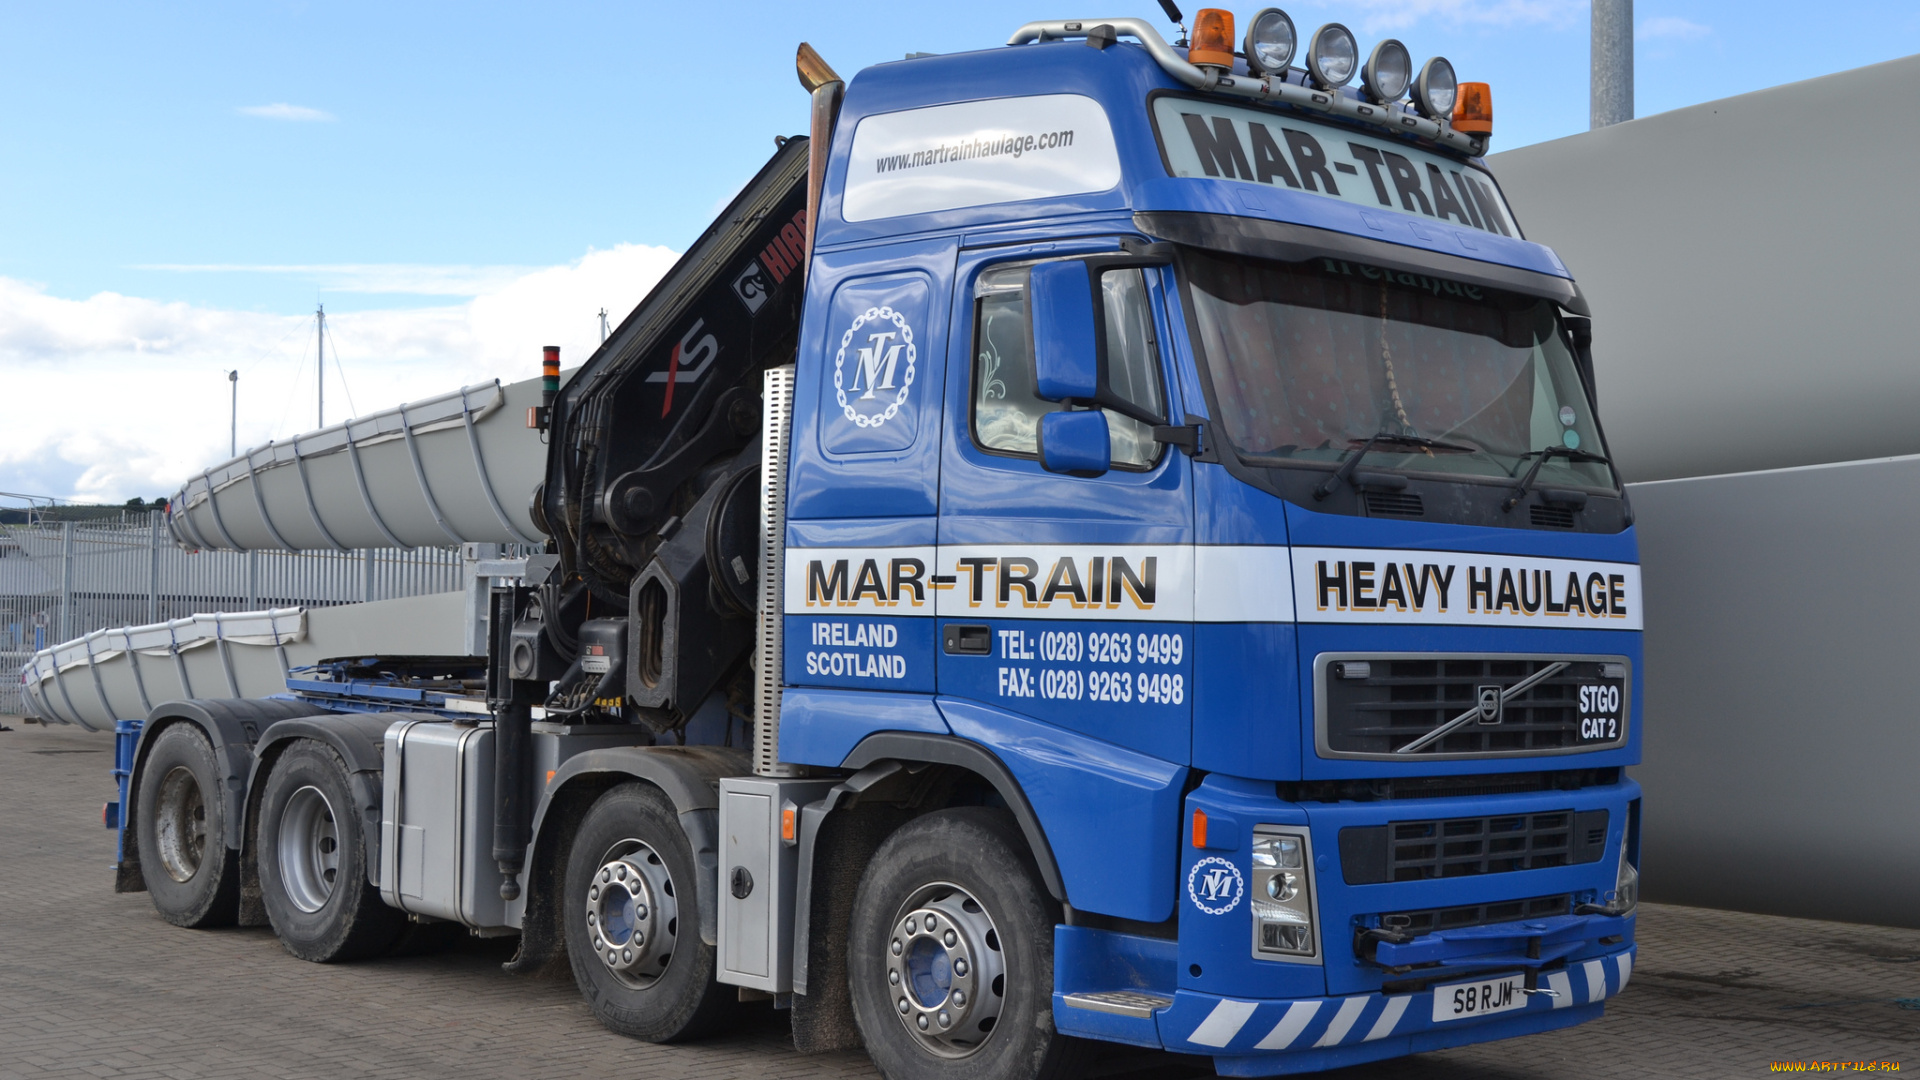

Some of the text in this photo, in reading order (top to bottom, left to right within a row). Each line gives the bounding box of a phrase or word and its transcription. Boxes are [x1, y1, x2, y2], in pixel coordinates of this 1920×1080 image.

[876, 129, 1074, 173] www.martrainhaulage.com
[1181, 112, 1512, 237] MAR-TRAIN
[645, 317, 719, 419] XS
[806, 556, 1158, 609] MAR-TRAIN
[1315, 560, 1627, 618] HEAVY HAULAGE
[811, 622, 898, 649] IRELAND
[998, 630, 1183, 665] TEL: (028) 9263 9499
[806, 652, 906, 679] SCOTLAND
[998, 668, 1184, 705] FAX: (028) 9263 9498
[1579, 685, 1619, 714] STGO
[1581, 717, 1616, 739] CAT 2
[1453, 980, 1513, 1014] S8 RJM
